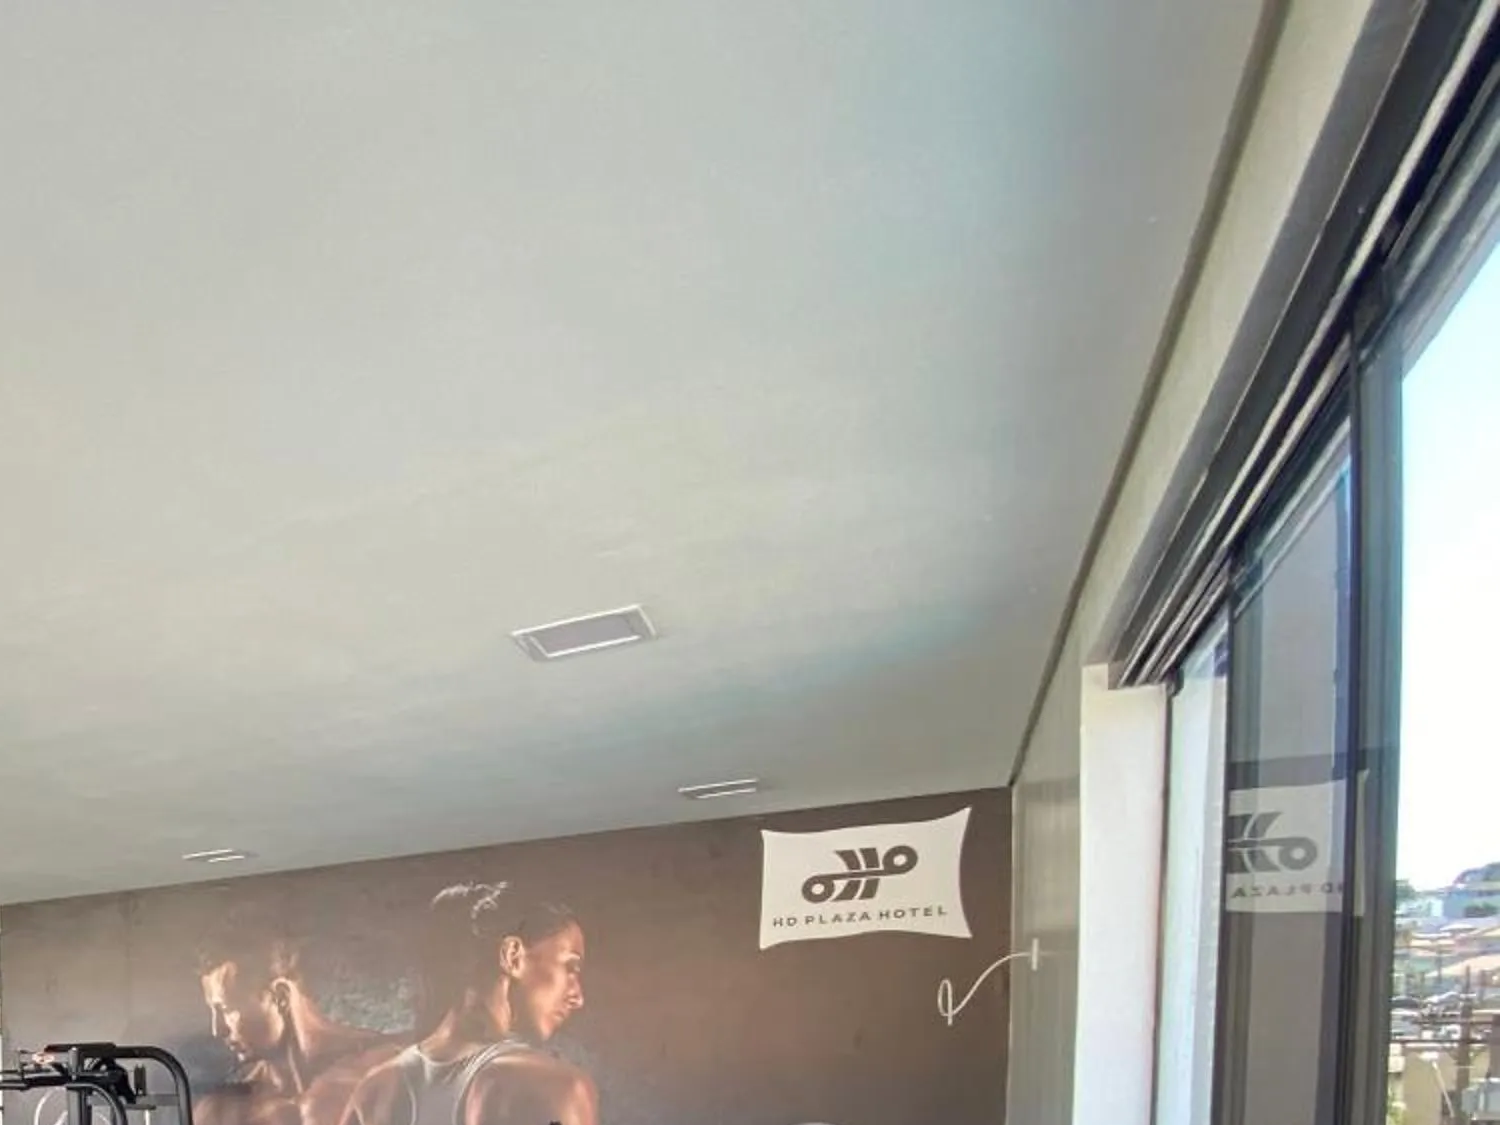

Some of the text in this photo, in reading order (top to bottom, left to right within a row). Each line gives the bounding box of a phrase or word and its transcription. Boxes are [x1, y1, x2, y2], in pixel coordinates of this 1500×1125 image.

[772, 905, 949, 928] HD PLAZA HOTEL
